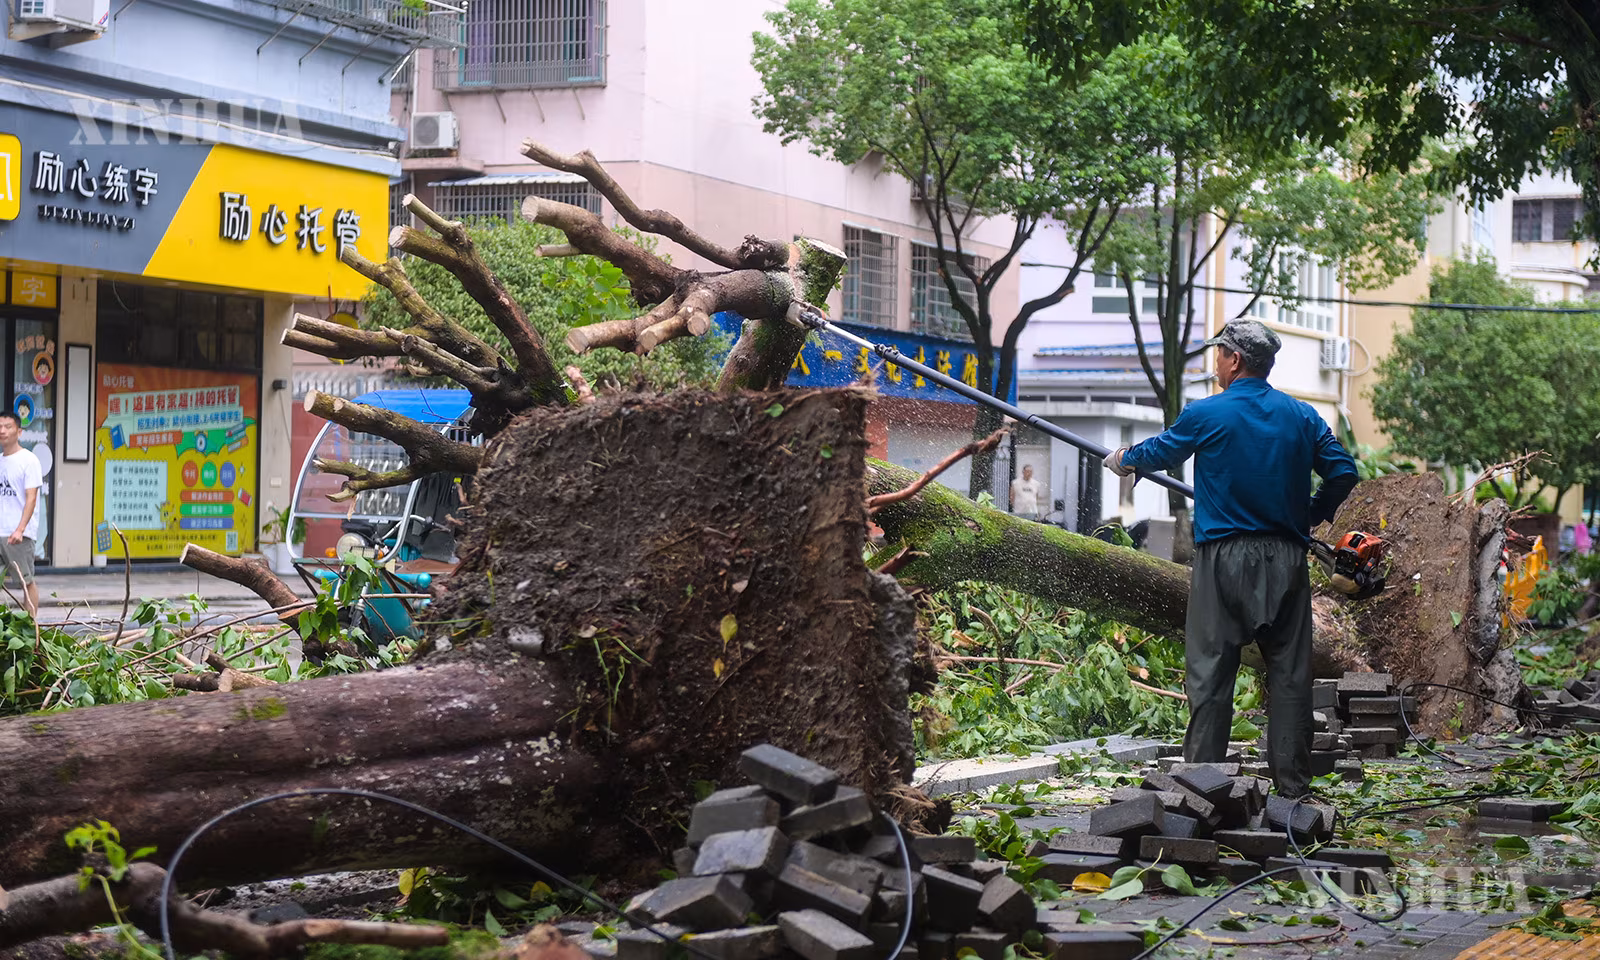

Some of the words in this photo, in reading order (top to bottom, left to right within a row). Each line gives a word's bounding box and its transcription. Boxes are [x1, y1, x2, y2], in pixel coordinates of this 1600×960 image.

[33, 150, 159, 206] 励心练字
[43, 204, 57, 218] LI
[62, 206, 82, 221] XIN
[88, 210, 118, 227] LIAN
[122, 215, 136, 230] ZI
[220, 191, 361, 257] 励心托管
[20, 277, 46, 304] 字
